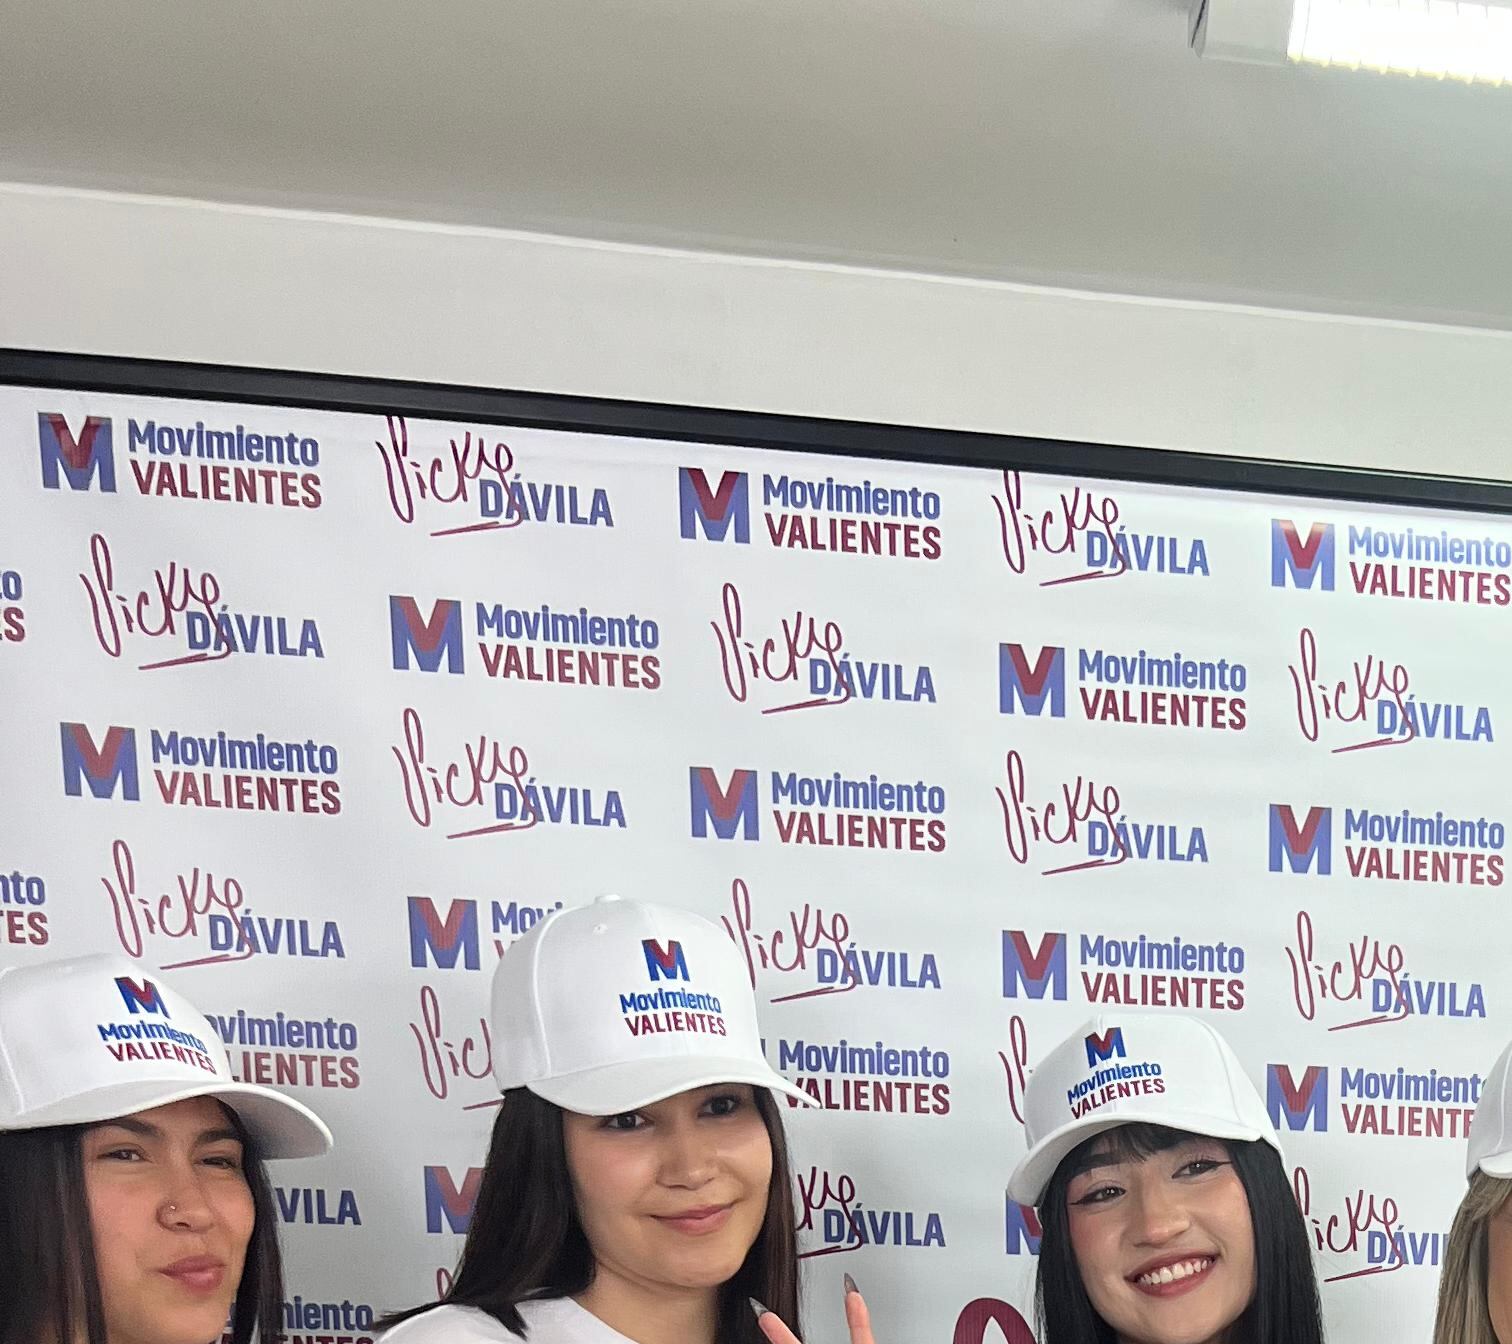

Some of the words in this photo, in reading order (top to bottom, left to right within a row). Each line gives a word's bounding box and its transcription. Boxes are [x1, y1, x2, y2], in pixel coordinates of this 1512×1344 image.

[128, 422, 319, 468] Movimiento
[131, 461, 322, 510] VALIENTES
[480, 473, 611, 528] DÁVILA
[763, 476, 941, 521] Movimiento
[764, 511, 942, 561] VALIENTES
[1086, 527, 1210, 577] DÁVILA
[1348, 527, 1512, 569] Movimiento
[1349, 561, 1512, 607] VALIENTES
[186, 606, 321, 658] DÁVILA
[476, 604, 659, 650] Movimiento
[479, 642, 661, 690] VALIENTES
[809, 652, 936, 704] DÁVILA
[1078, 649, 1247, 693] Movimiento
[1079, 687, 1247, 731] VALIENTES
[1376, 694, 1494, 743] DÁVILA
[151, 733, 337, 775] Movimiento
[154, 770, 341, 815] VALIENTES
[495, 779, 625, 828] DÁVILA
[771, 773, 946, 815] Movimiento
[773, 810, 947, 853] VALIENTES
[1087, 816, 1208, 863] DÁVILA
[1344, 808, 1505, 850] Movimiento
[1345, 846, 1505, 887] VALIENTES
[209, 906, 344, 958] DÁVILA
[816, 941, 941, 989] DÁVILA
[1080, 936, 1245, 974] Movimiento
[618, 987, 722, 1015] Movimiento
[1082, 971, 1245, 1012] VALIENTES
[1371, 976, 1487, 1018] DÁVILA
[96, 1020, 208, 1053] Movimiento
[626, 1011, 727, 1037] VALIENTES
[106, 1041, 214, 1073] VALIENTES
[779, 1040, 950, 1079] Movimiento
[1066, 1062, 1162, 1104] Movimiento
[824, 1203, 944, 1248] DÁVILA
